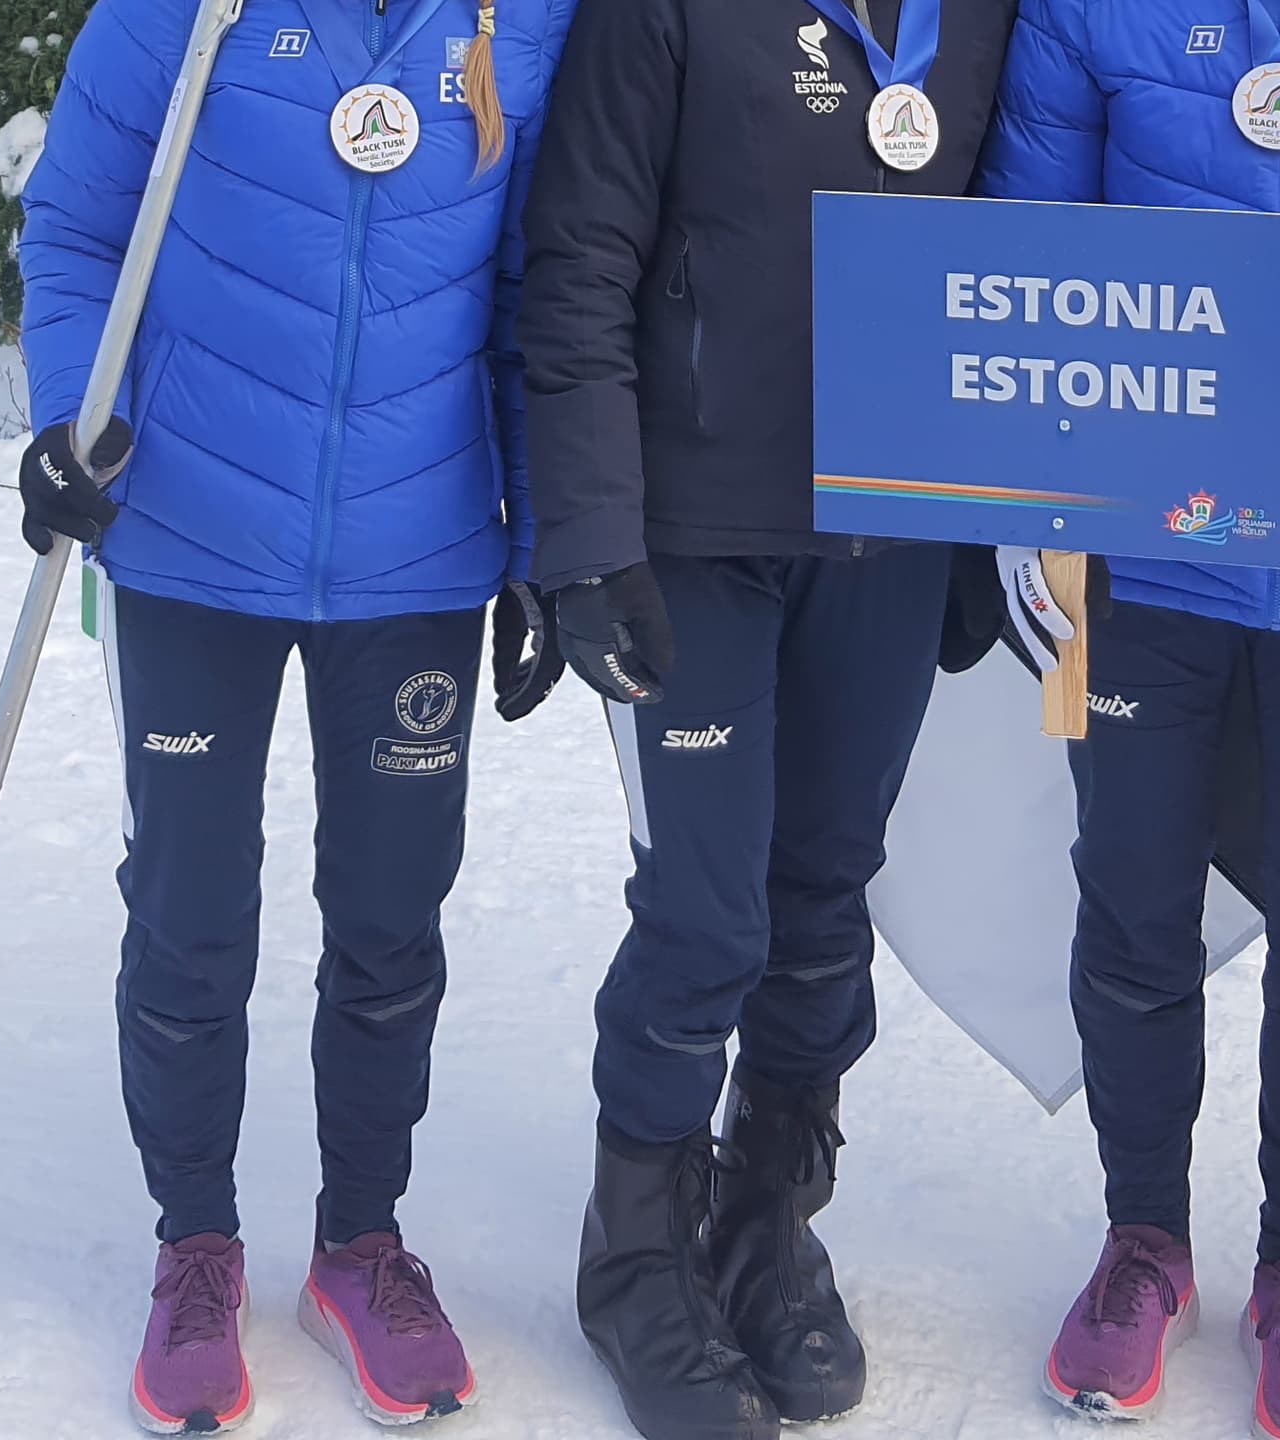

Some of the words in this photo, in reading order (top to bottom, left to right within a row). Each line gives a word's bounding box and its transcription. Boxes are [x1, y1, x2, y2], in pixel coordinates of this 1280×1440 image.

[792, 71, 829, 82] TEAM
[439, 72, 467, 103] ES
[794, 82, 848, 95] ESTONIA
[1248, 117, 1278, 129] BLACK
[352, 143, 381, 155] BLACK
[382, 138, 406, 150] TUSK
[884, 142, 907, 150] BLACK
[908, 141, 928, 150] TUSK
[946, 272, 1226, 335] ESTONIA
[951, 353, 1217, 416] ESTONIE
[1238, 507, 1265, 519] 2023
[399, 674, 454, 704] SUUSASEMUD
